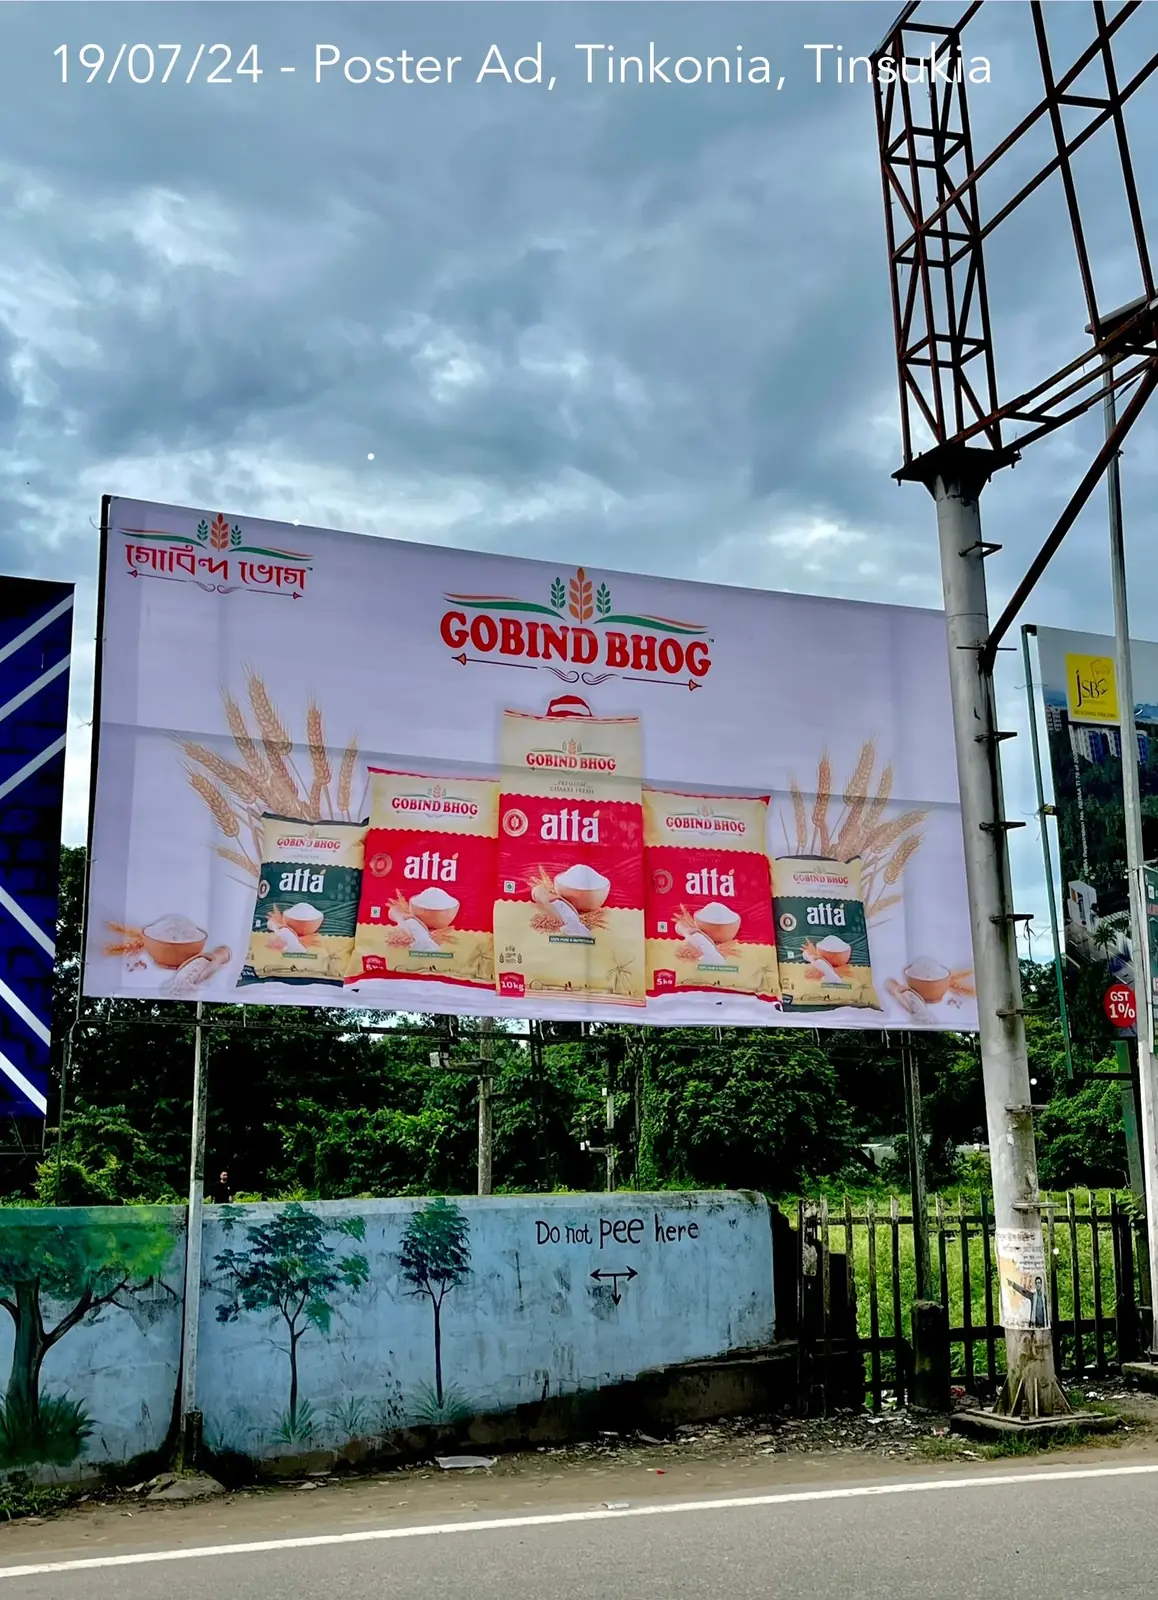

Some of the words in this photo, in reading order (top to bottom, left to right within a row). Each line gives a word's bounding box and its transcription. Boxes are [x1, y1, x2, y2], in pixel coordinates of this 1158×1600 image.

[125, 544, 228, 581] গোবিন্দ
[238, 561, 306, 590] ভোগ
[440, 611, 599, 665] GOBIND
[605, 631, 712, 677] BHOG
[526, 752, 578, 769] GOBIND
[580, 755, 616, 771] BHOG
[391, 797, 441, 812] GOBIND
[443, 799, 479, 816] BHOG
[665, 816, 713, 830] GOBIND
[714, 819, 746, 833] BHOG
[277, 838, 313, 848] GOBIND
[313, 840, 341, 850] BHOG
[793, 874, 826, 883] GOBIND
[826, 876, 849, 885] BHOG
[1110, 991, 1129, 1002] GST
[1108, 1003, 1135, 1019] 1%
[535, 1220, 561, 1245] Do
[565, 1223, 593, 1244] not
[599, 1217, 645, 1249] pee
[654, 1213, 699, 1243] here
